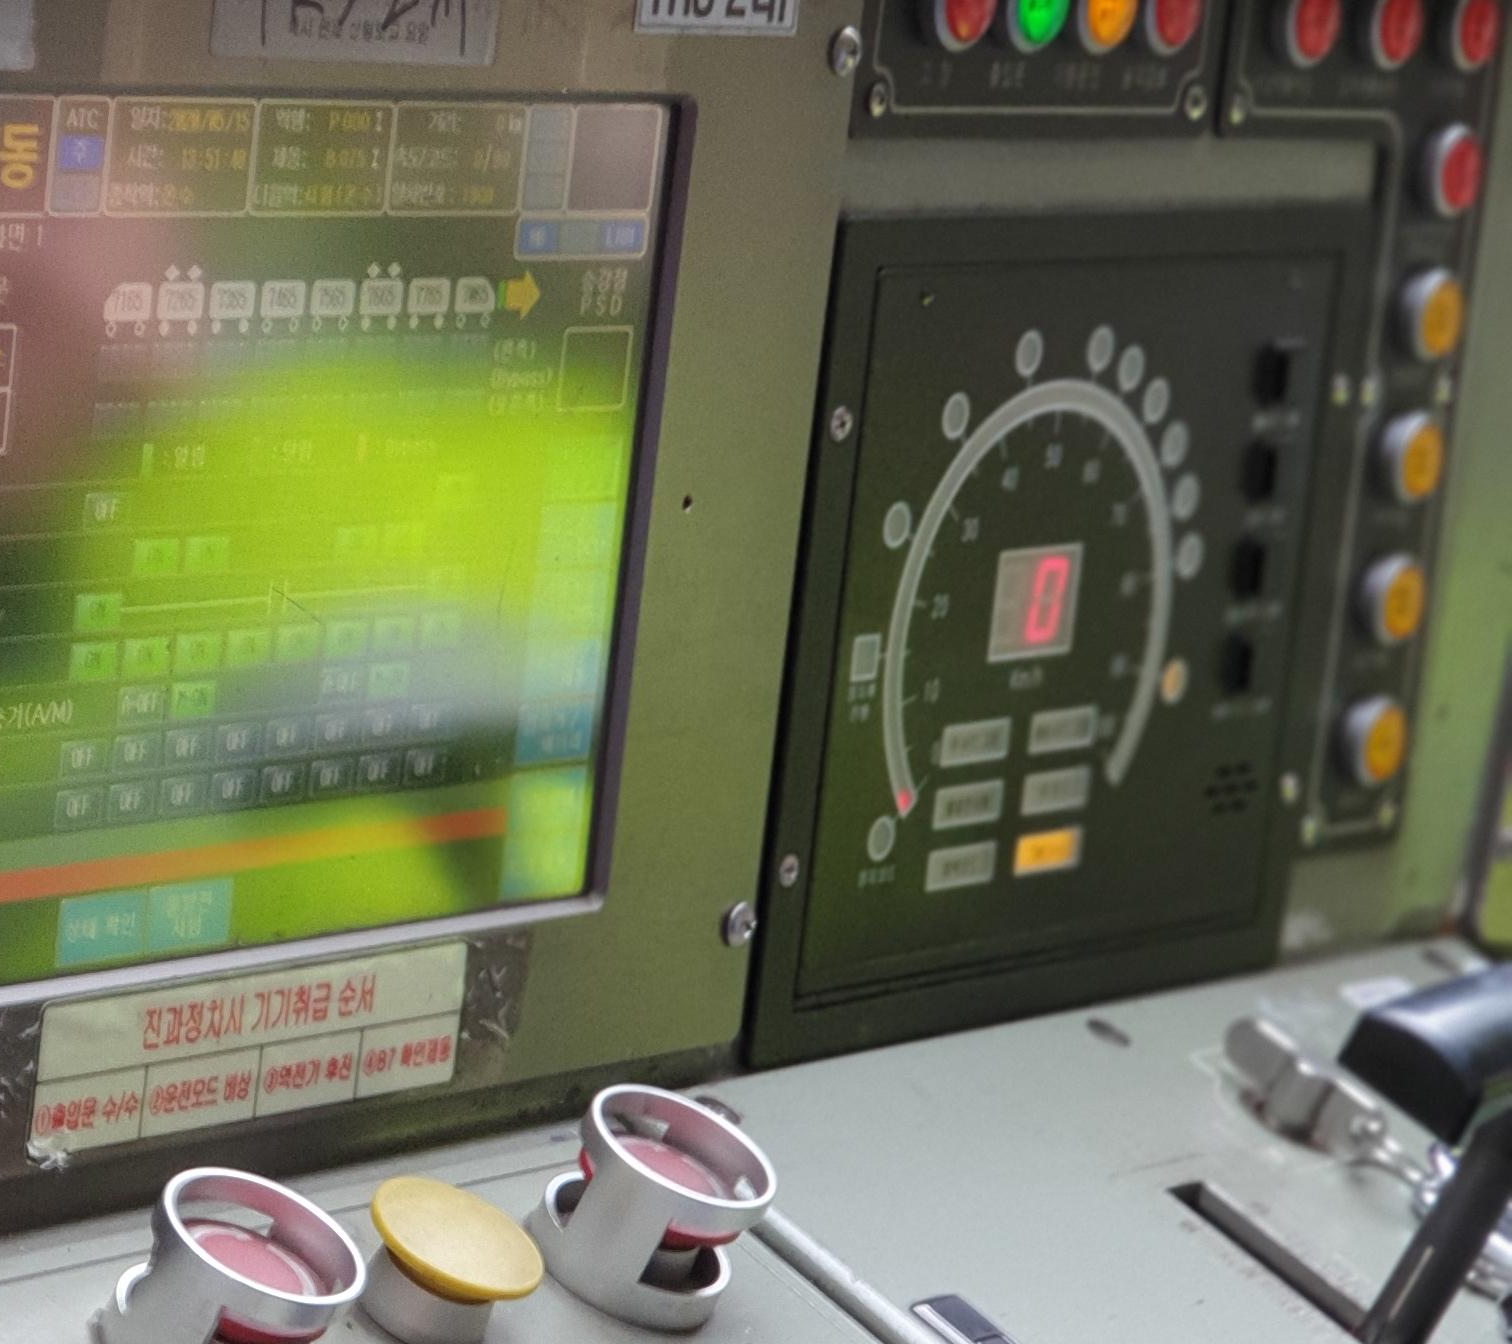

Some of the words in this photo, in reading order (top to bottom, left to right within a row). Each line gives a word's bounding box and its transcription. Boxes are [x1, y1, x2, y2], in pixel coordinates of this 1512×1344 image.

[66, 108, 99, 130] ATC
[579, 293, 622, 318] PSD
[1024, 556, 1071, 644] 0
[252, 985, 332, 1032] 기기취급
[339, 974, 377, 1017] 순서
[101, 1093, 139, 1123] 수/수
